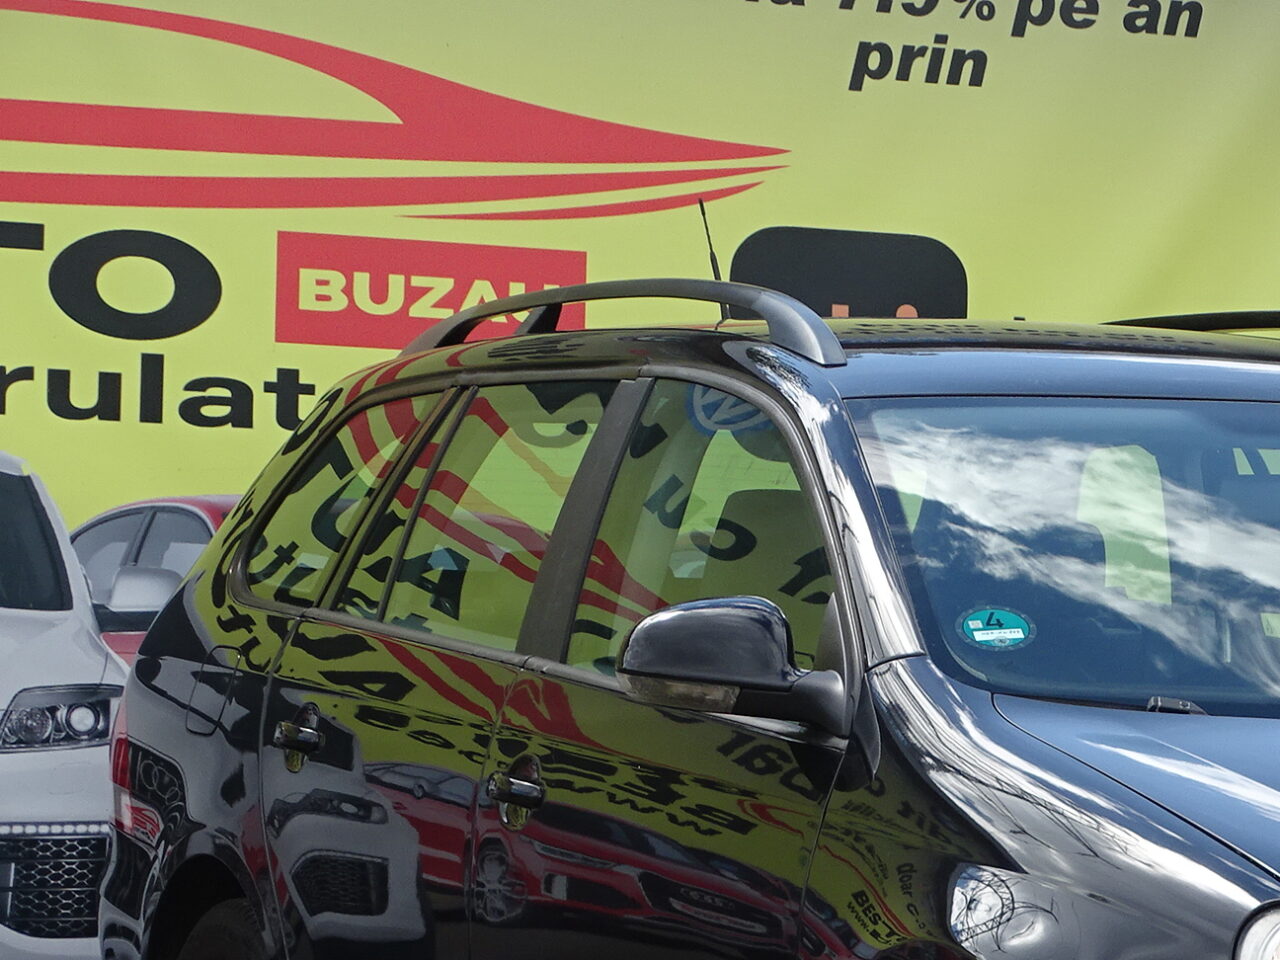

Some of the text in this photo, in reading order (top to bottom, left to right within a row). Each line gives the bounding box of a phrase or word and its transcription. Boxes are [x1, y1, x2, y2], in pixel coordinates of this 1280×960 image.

[1011, 0, 1099, 38] pe
[1122, 0, 1204, 38] an
[848, 34, 988, 91] prin
[0, 352, 316, 431] rulat
[985, 612, 1005, 628] 4
